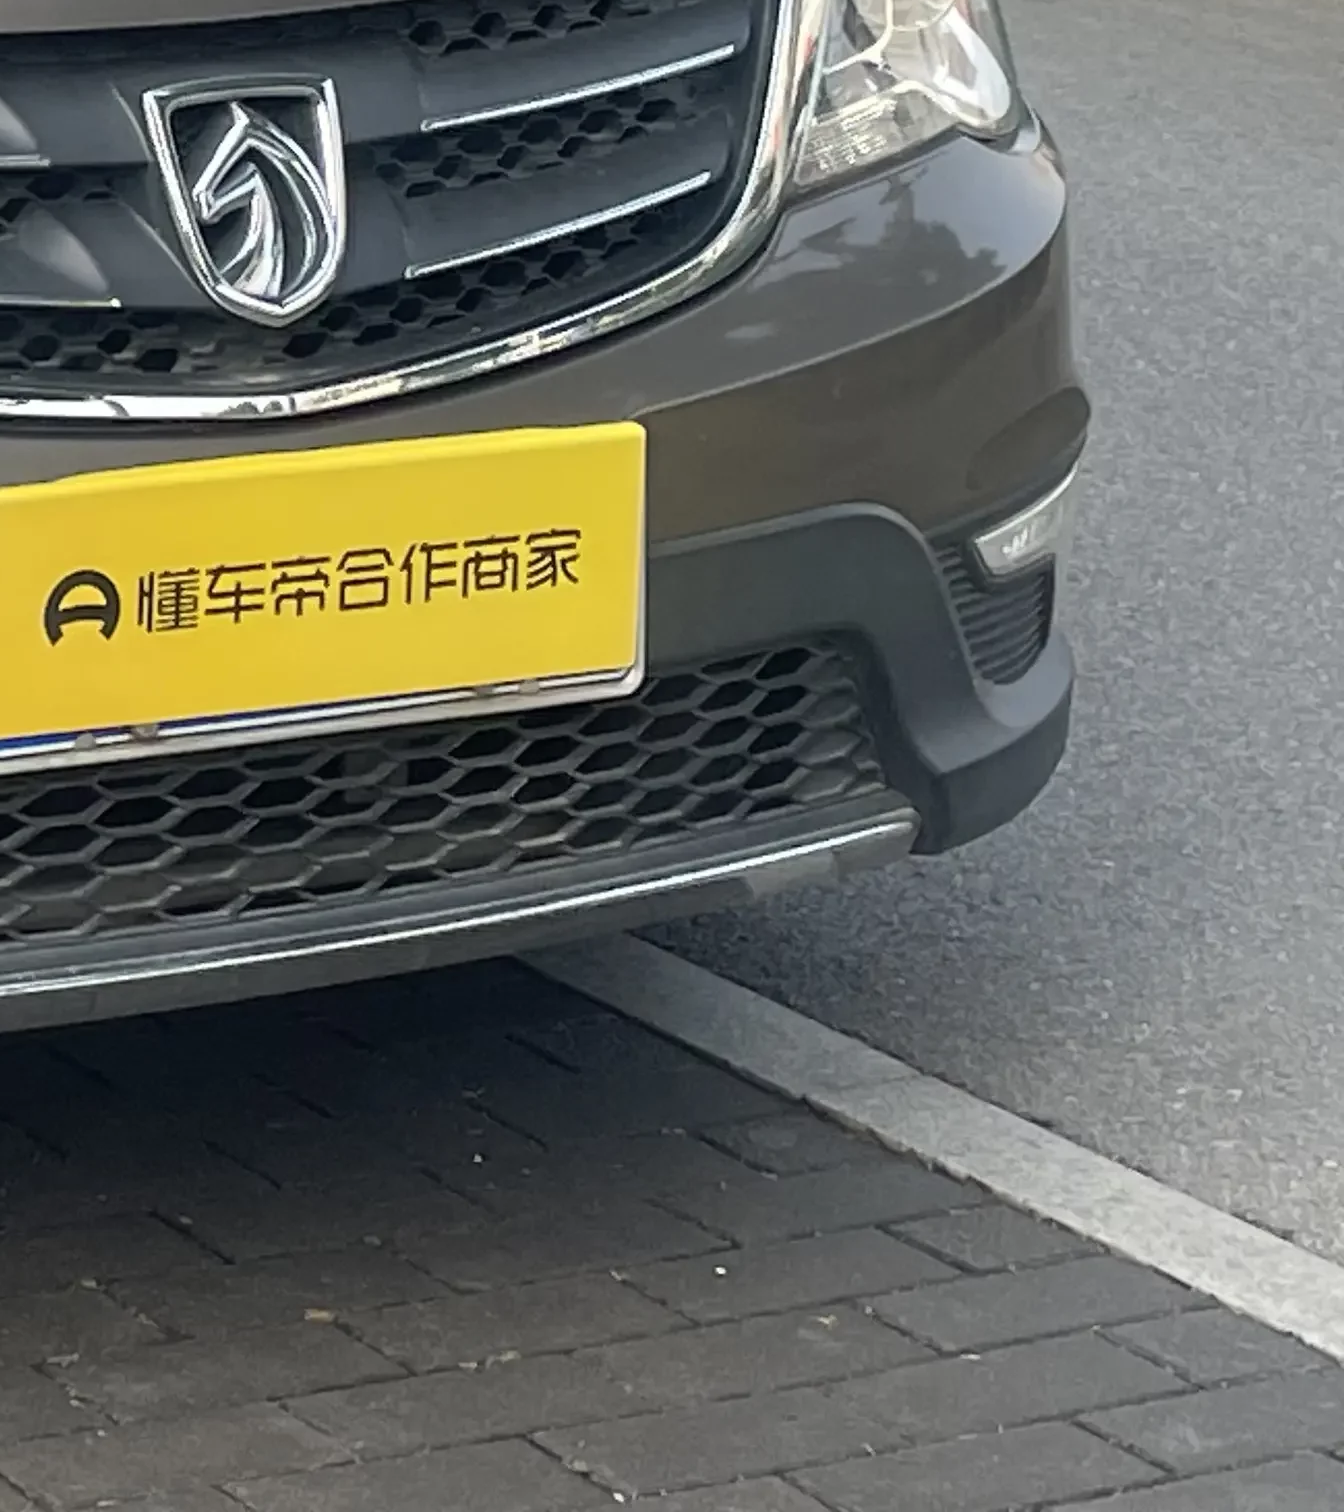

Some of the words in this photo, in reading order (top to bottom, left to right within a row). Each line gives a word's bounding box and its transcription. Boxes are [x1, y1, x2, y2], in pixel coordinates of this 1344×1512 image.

[136, 528, 583, 634] 懂车帝合作商家
